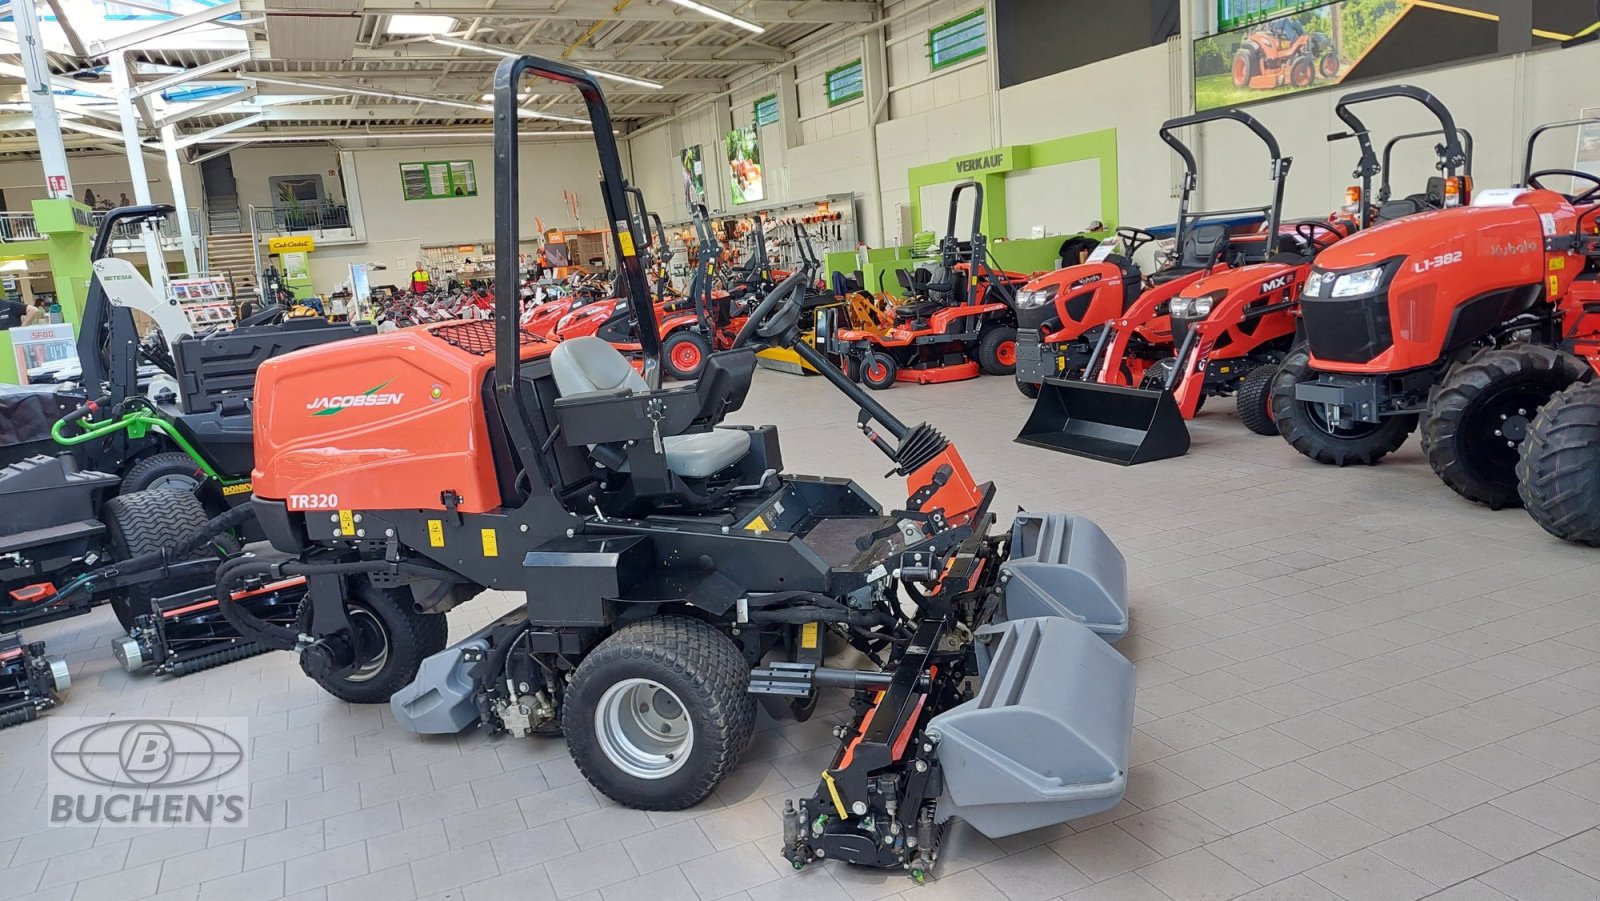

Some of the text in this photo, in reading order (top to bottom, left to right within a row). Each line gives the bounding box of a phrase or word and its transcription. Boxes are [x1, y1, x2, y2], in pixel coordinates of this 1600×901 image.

[956, 153, 1004, 174] VERKAUF
[1491, 238, 1538, 257] Kubota
[1413, 251, 1463, 273] L1-382
[1262, 275, 1286, 293] MX
[306, 392, 404, 410] JACOBSEN
[222, 483, 253, 494] DONKY
[290, 493, 339, 509] TR320
